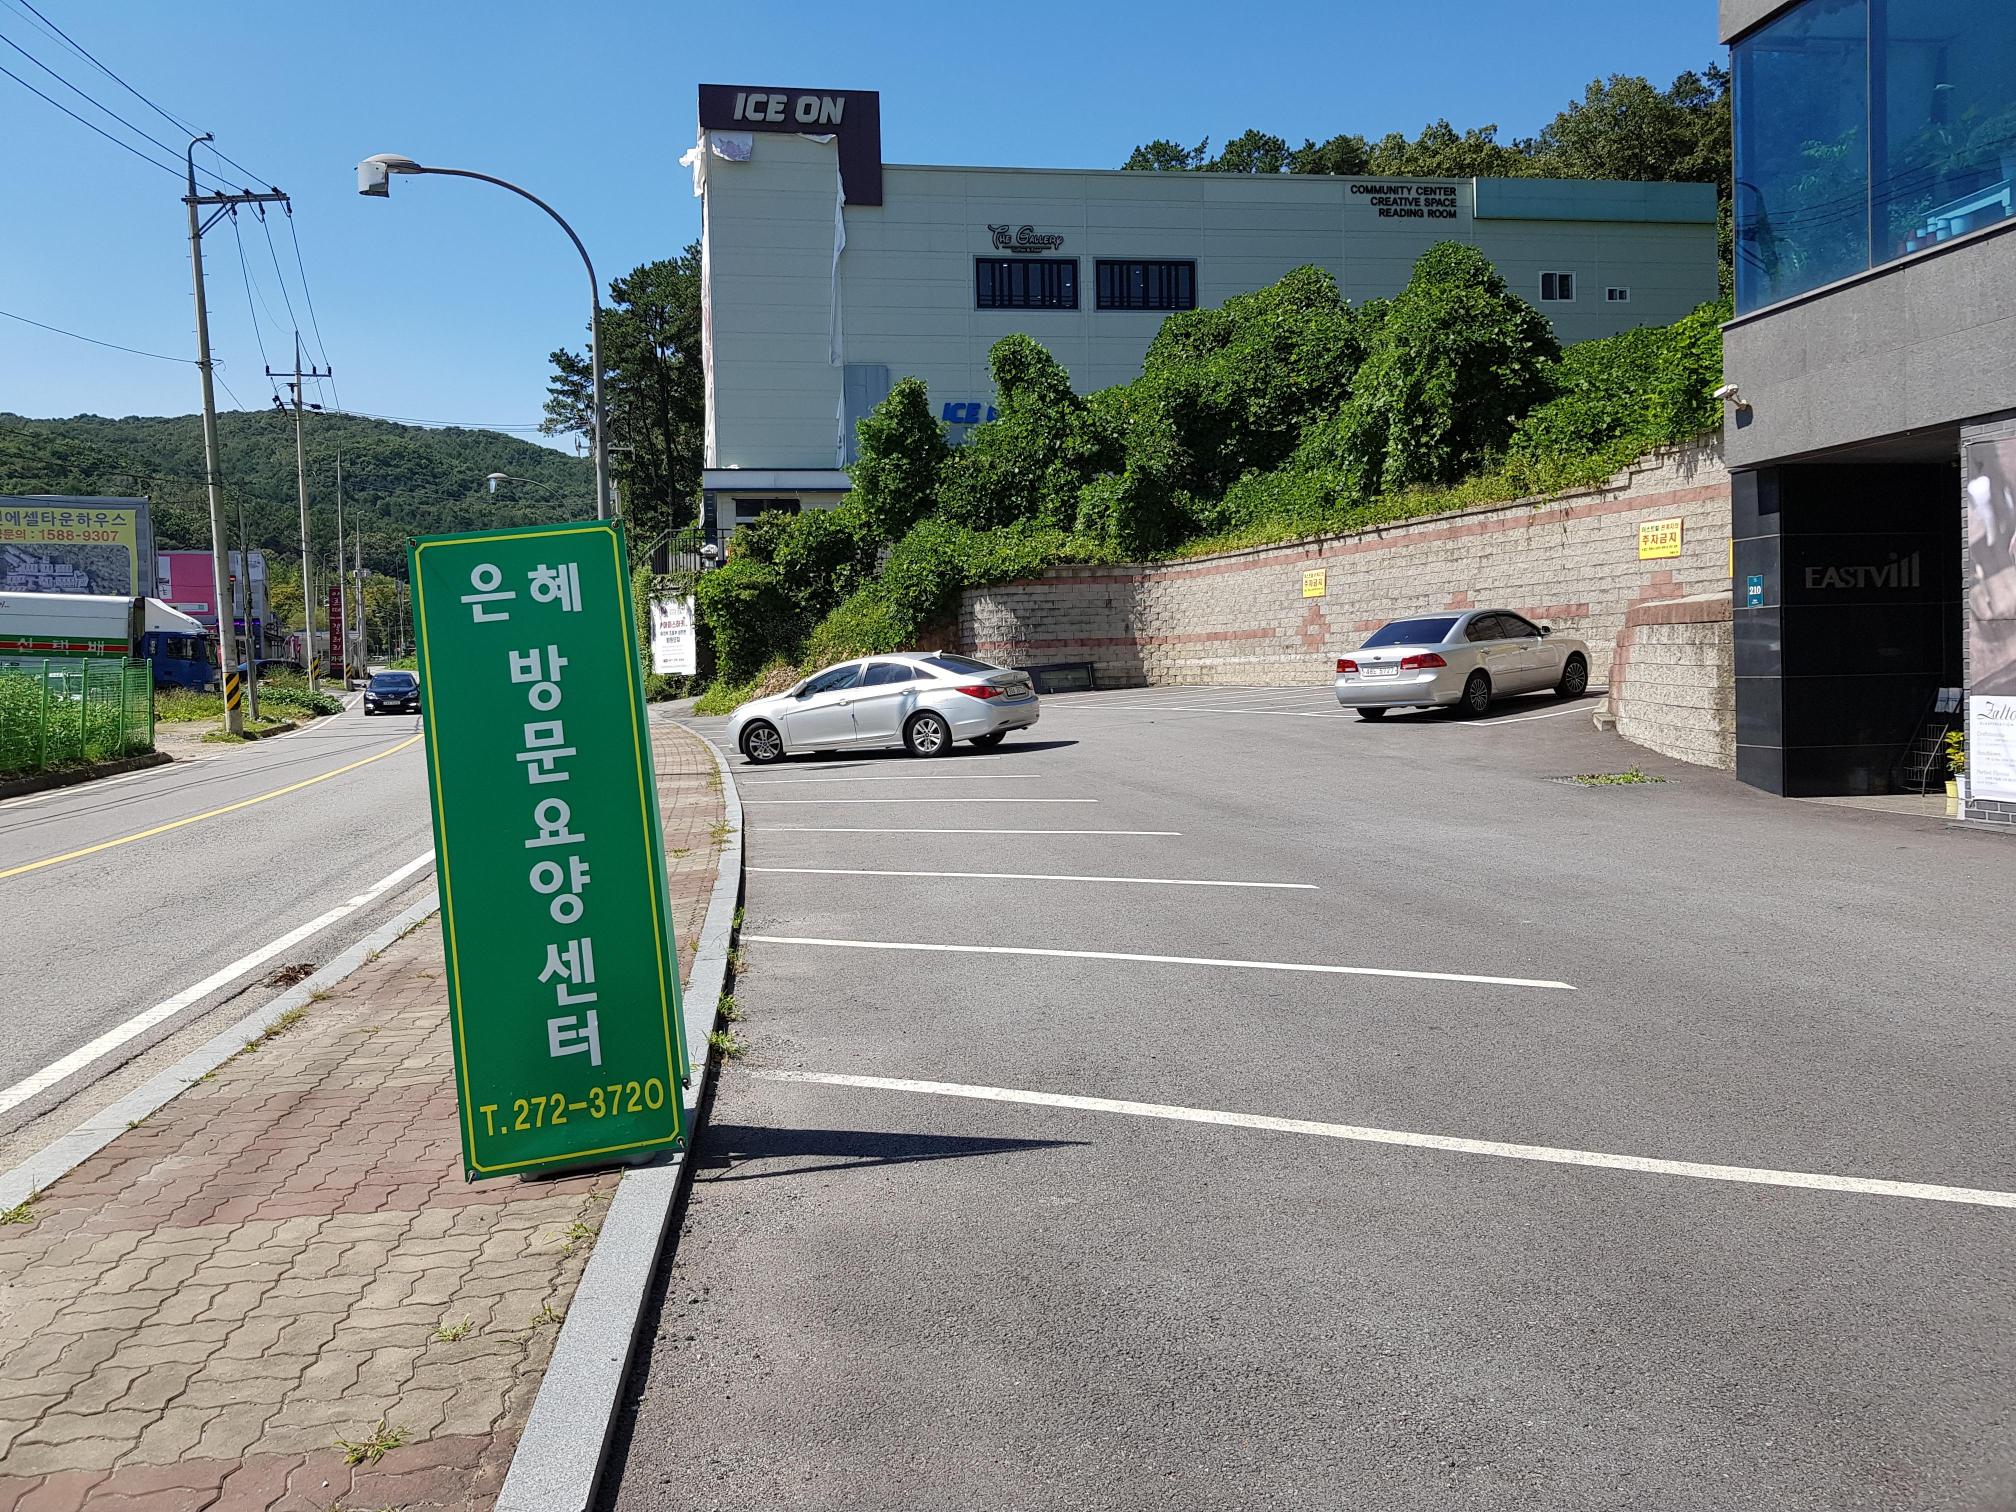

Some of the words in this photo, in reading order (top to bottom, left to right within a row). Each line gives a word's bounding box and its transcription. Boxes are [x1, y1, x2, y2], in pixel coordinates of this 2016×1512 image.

[734, 93, 787, 122] ICE
[795, 96, 845, 125] ON
[1350, 184, 1412, 195] COMMUNITY
[1416, 186, 1456, 196] CENTER
[1370, 196, 1420, 206] CREATIVE
[1424, 198, 1456, 207] SPACE
[1379, 208, 1424, 218] READING
[1428, 209, 1456, 218] ROOM
[942, 403, 981, 423] ICE
[39, 529, 119, 541] 1588-9307
[1749, 585, 1762, 595] 210
